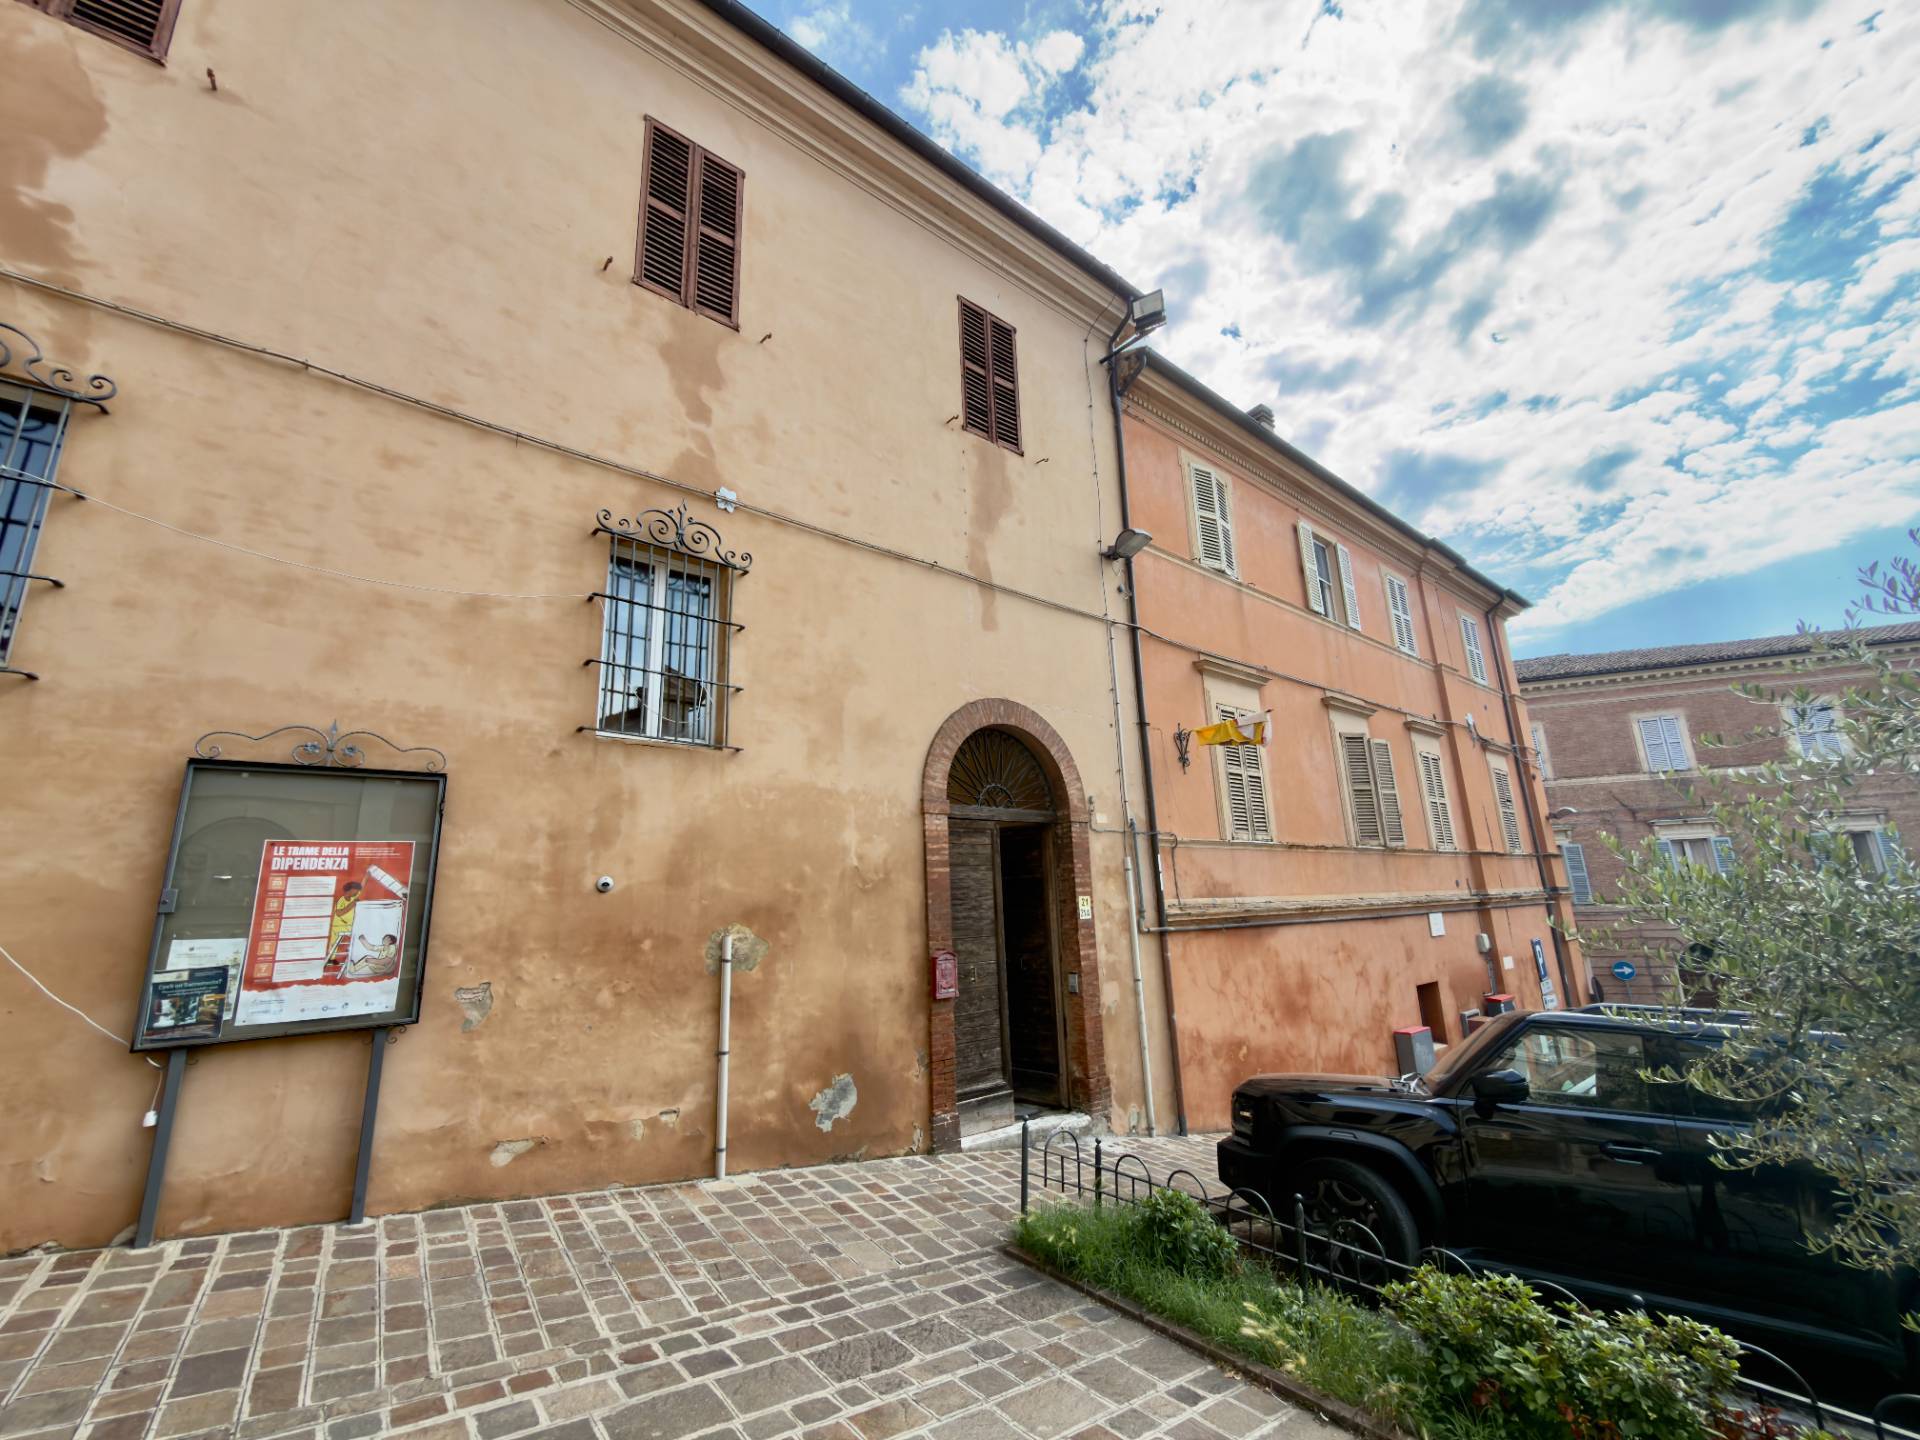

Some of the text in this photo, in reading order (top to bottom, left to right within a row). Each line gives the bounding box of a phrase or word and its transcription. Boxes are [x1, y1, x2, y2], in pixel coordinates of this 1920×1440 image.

[274, 846, 285, 856] LE
[288, 846, 320, 856] TRAME
[322, 847, 350, 856] DELLA
[272, 858, 348, 870] DIPENDENZA
